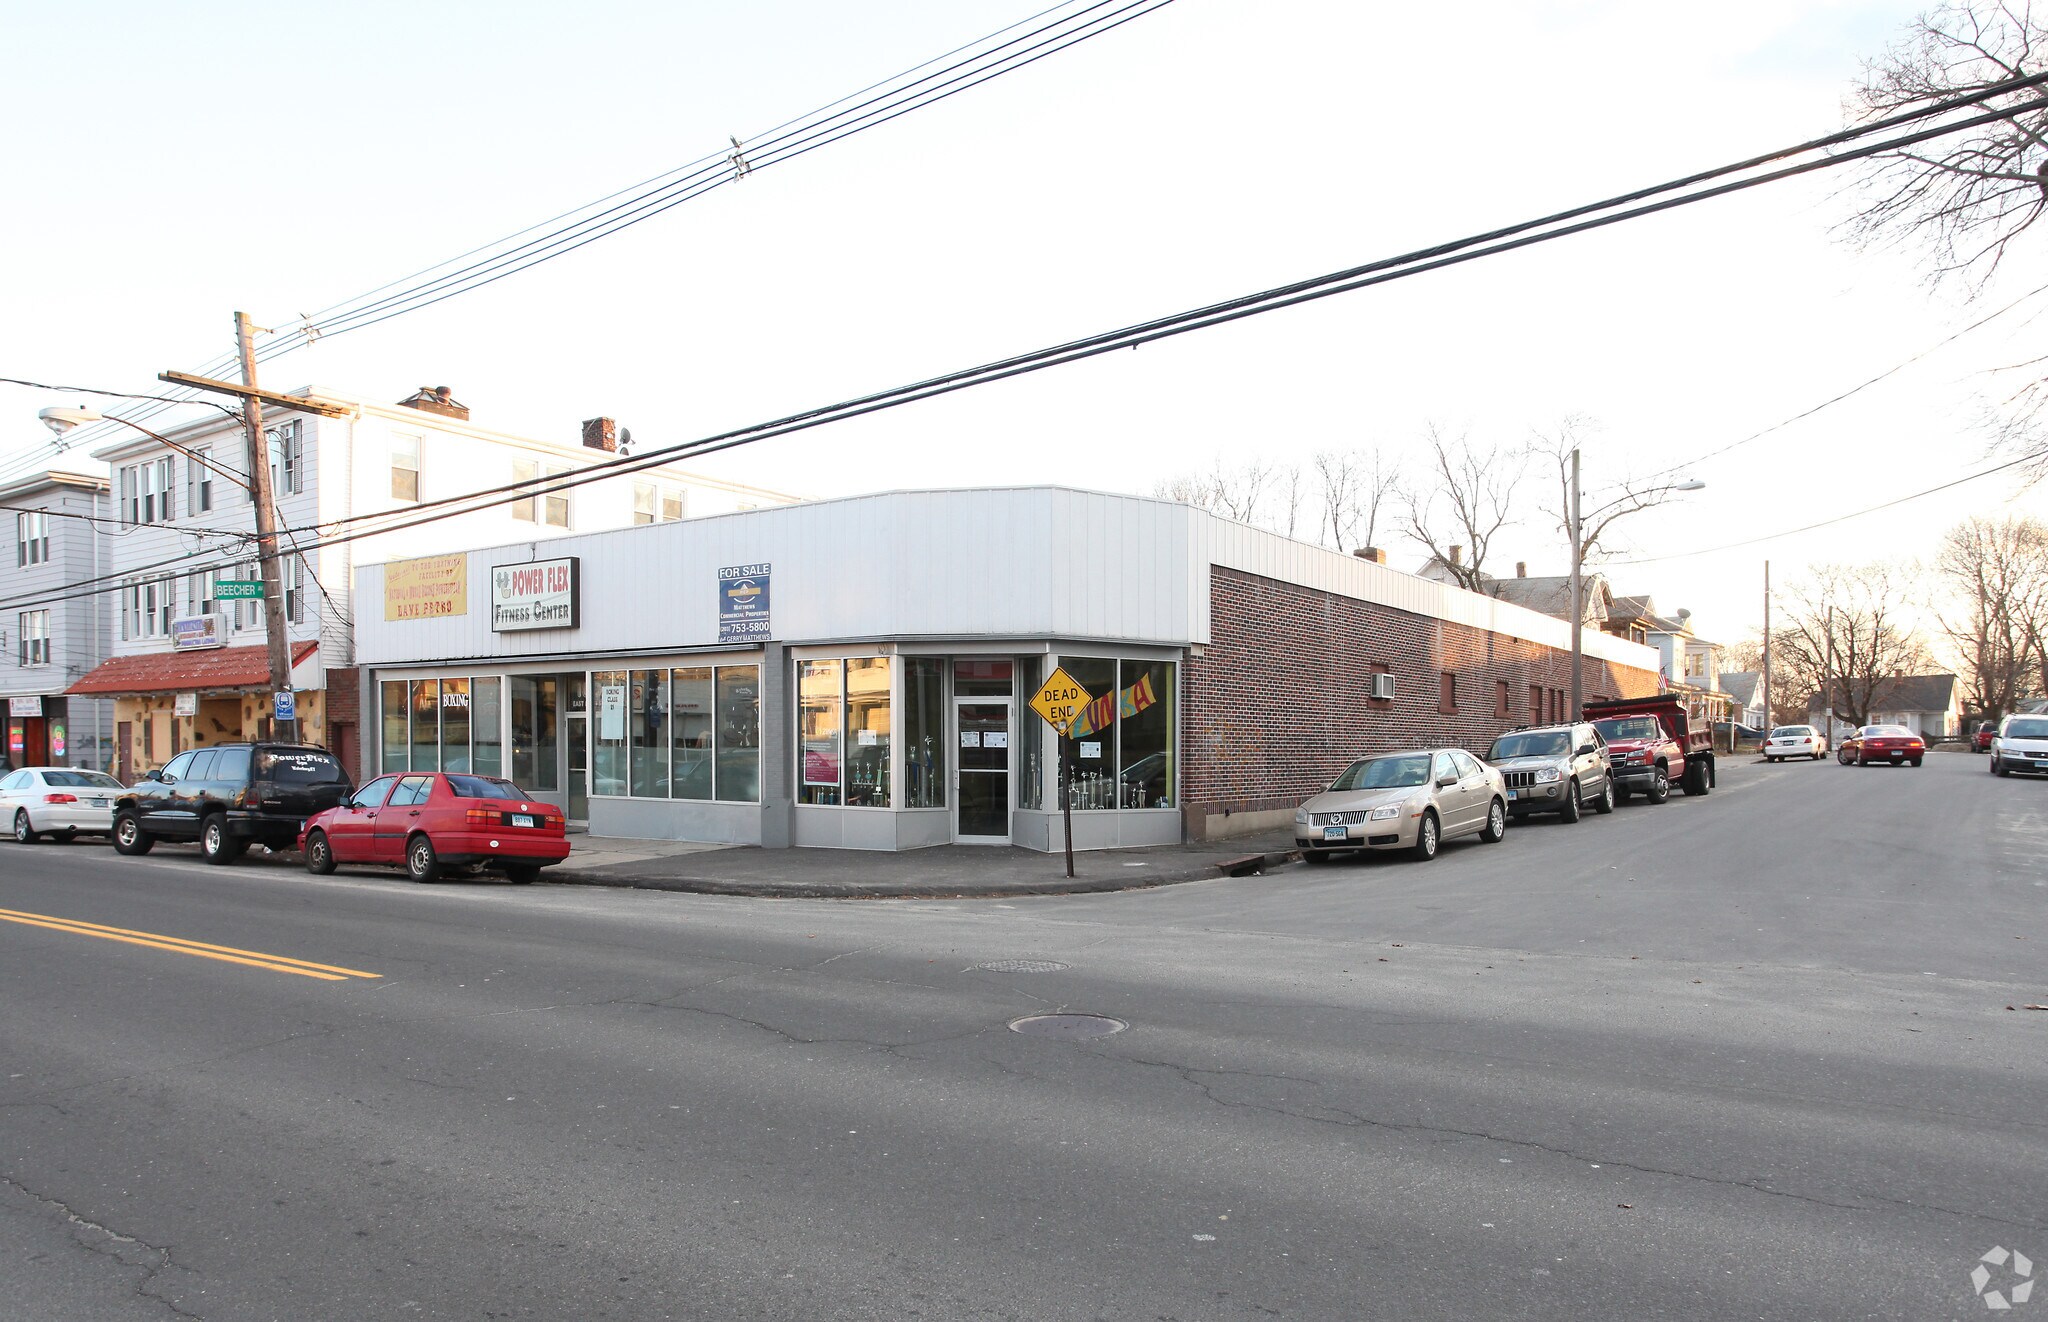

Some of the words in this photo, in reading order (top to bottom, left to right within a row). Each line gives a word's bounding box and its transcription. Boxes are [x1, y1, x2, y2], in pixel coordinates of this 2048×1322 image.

[720, 567, 740, 579] FOR
[743, 564, 770, 576] SALE
[512, 568, 544, 597] POWER
[547, 565, 569, 593] FLEX
[217, 584, 256, 596] BEECHER
[397, 603, 420, 617] DAVE
[731, 621, 770, 633] 753-5800
[743, 633, 771, 641] MATTHEWS
[443, 693, 469, 707] BOXING
[1044, 688, 1078, 702] DEAD
[1050, 706, 1075, 719] END
